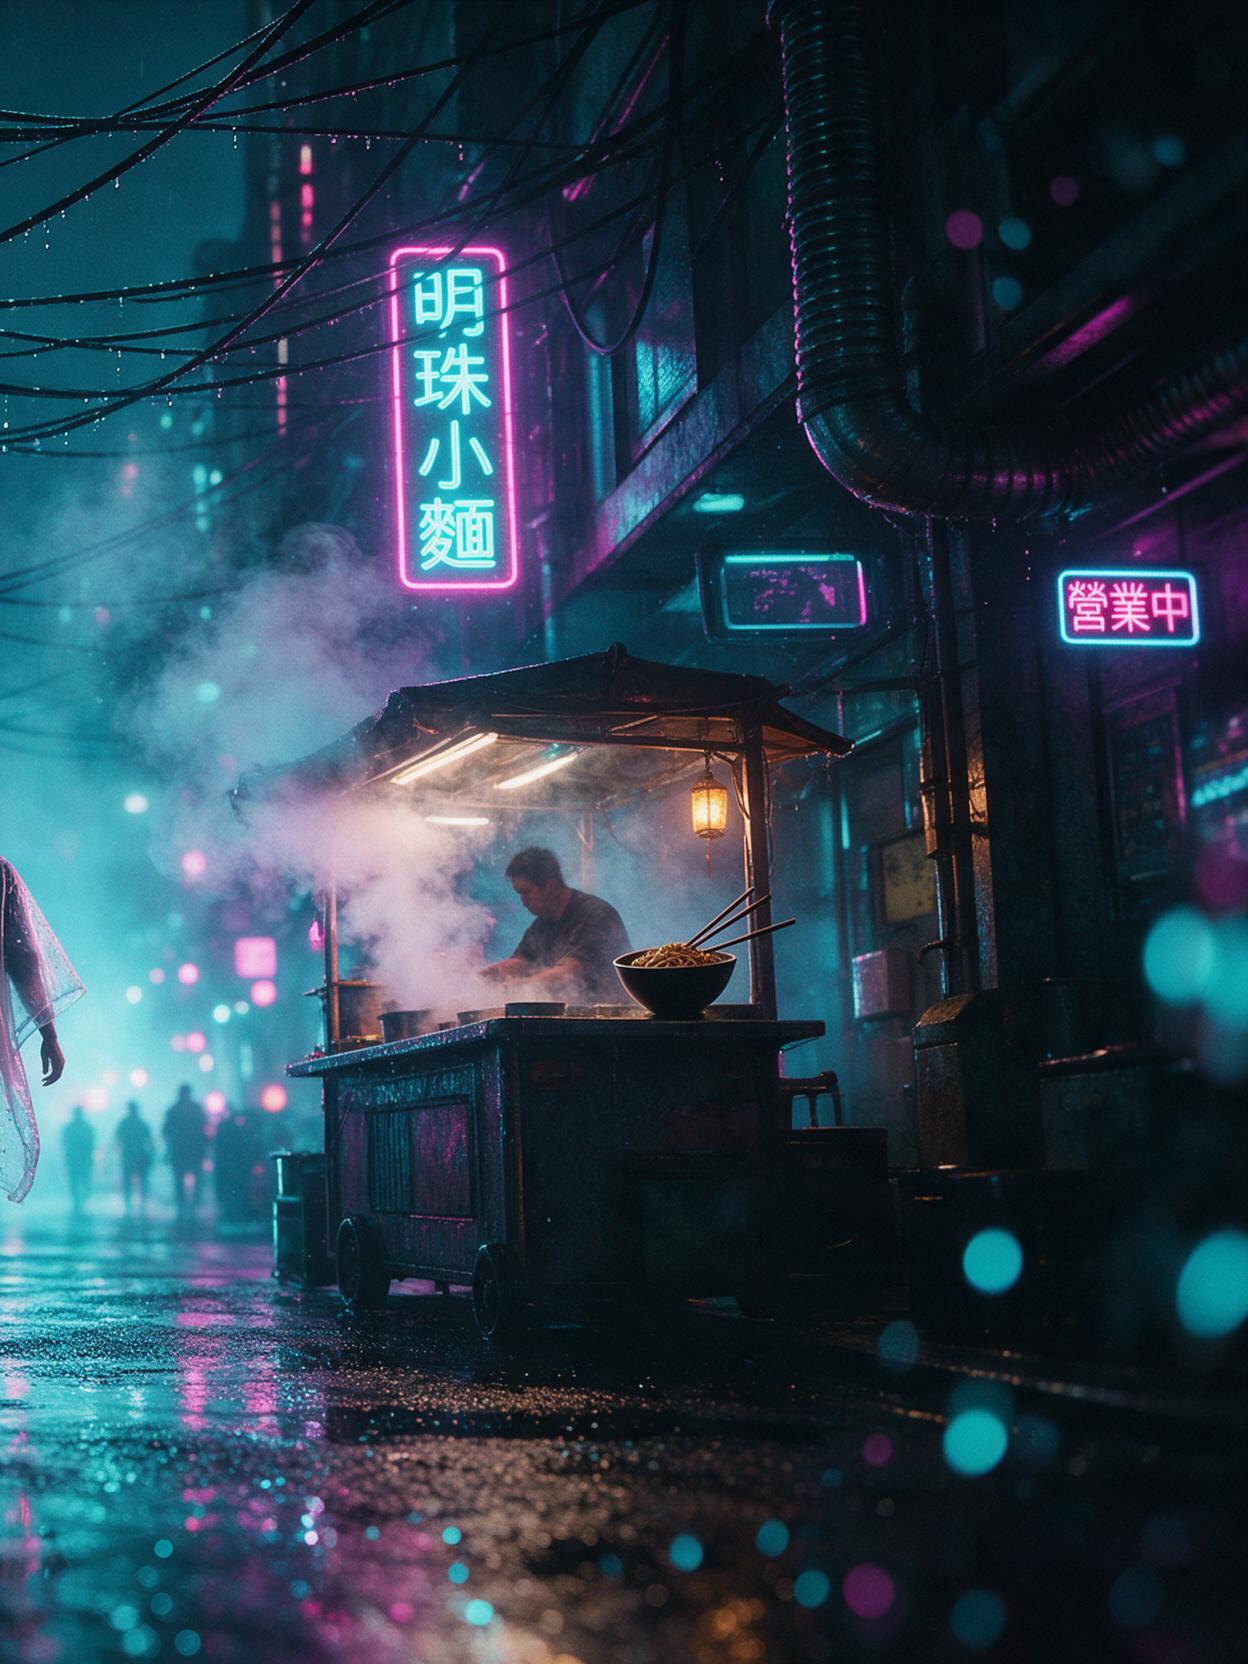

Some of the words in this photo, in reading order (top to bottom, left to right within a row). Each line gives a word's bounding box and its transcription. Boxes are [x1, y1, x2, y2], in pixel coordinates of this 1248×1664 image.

[412, 267, 498, 571] 明珠小麵
[1067, 580, 1189, 633] 營業中
